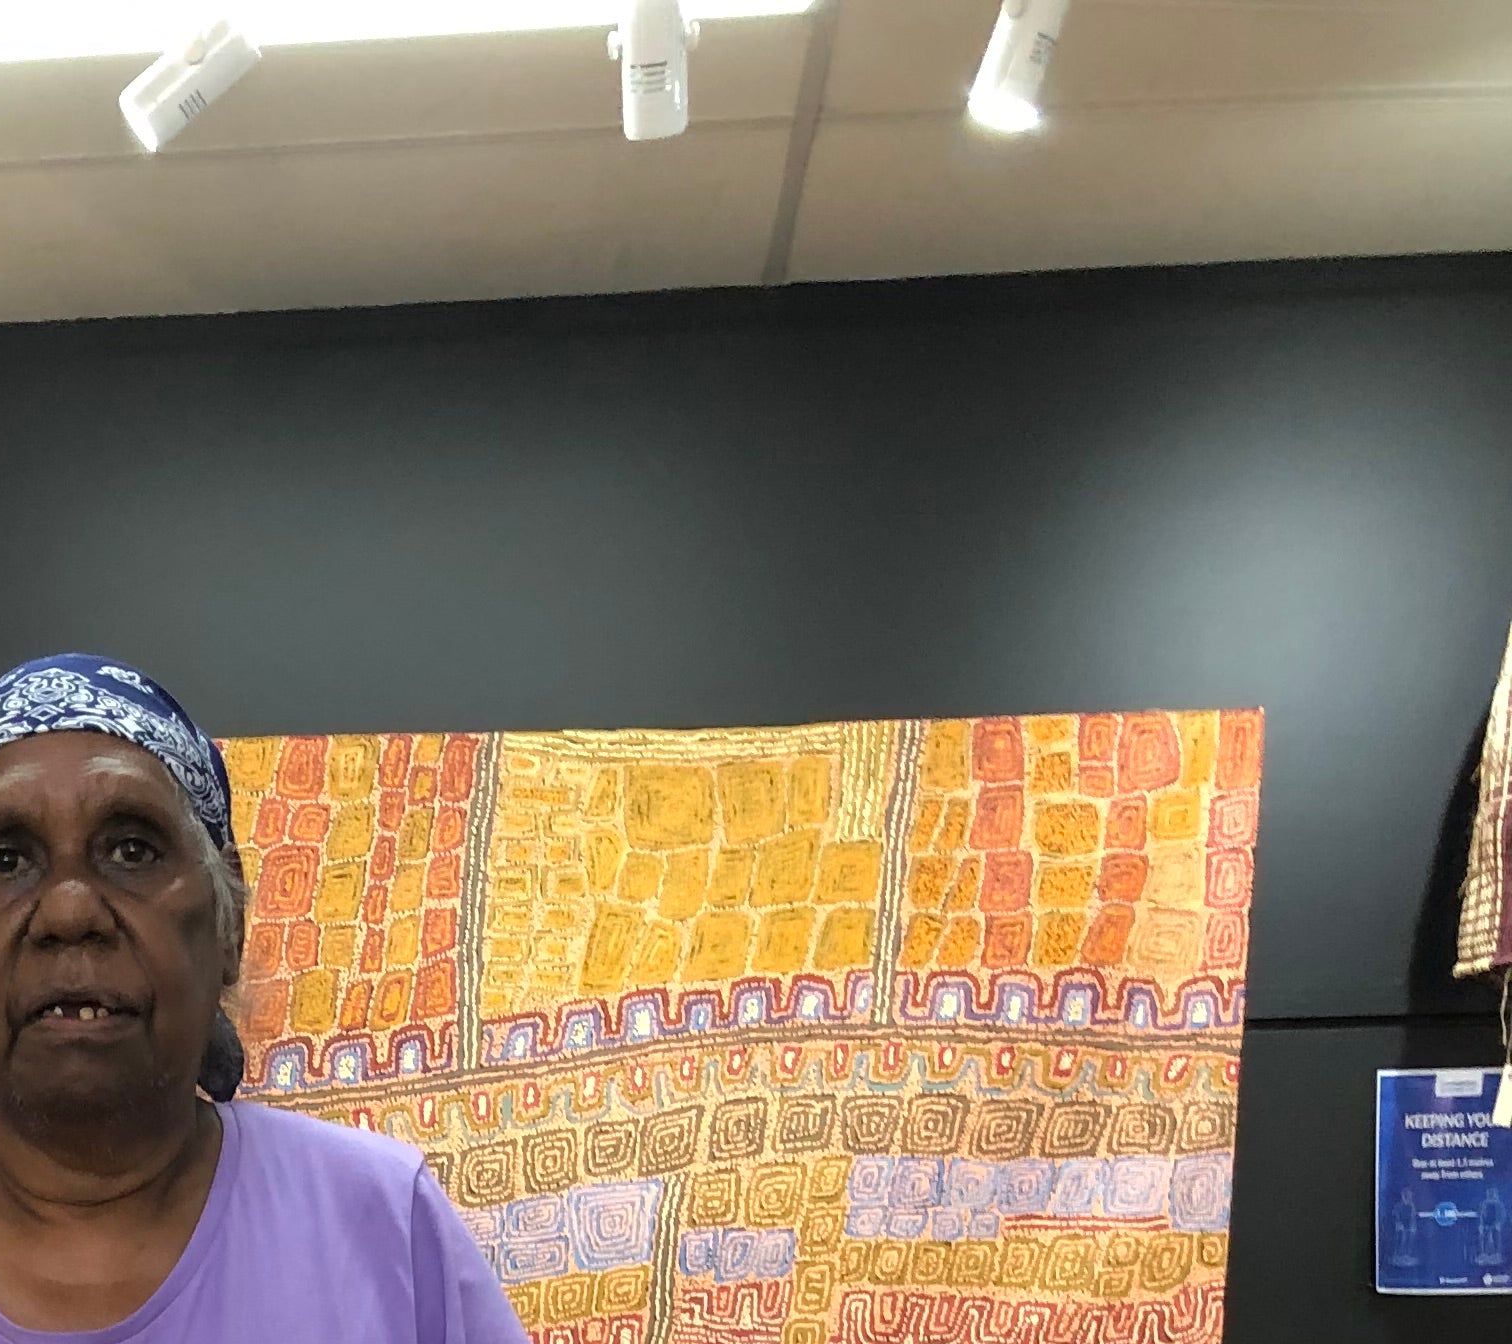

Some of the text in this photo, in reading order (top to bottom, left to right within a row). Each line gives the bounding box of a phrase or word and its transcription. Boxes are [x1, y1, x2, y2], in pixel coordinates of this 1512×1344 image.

[1404, 1112, 1496, 1129] KEEPING YOU
[1421, 1132, 1489, 1149] DISTANCE
